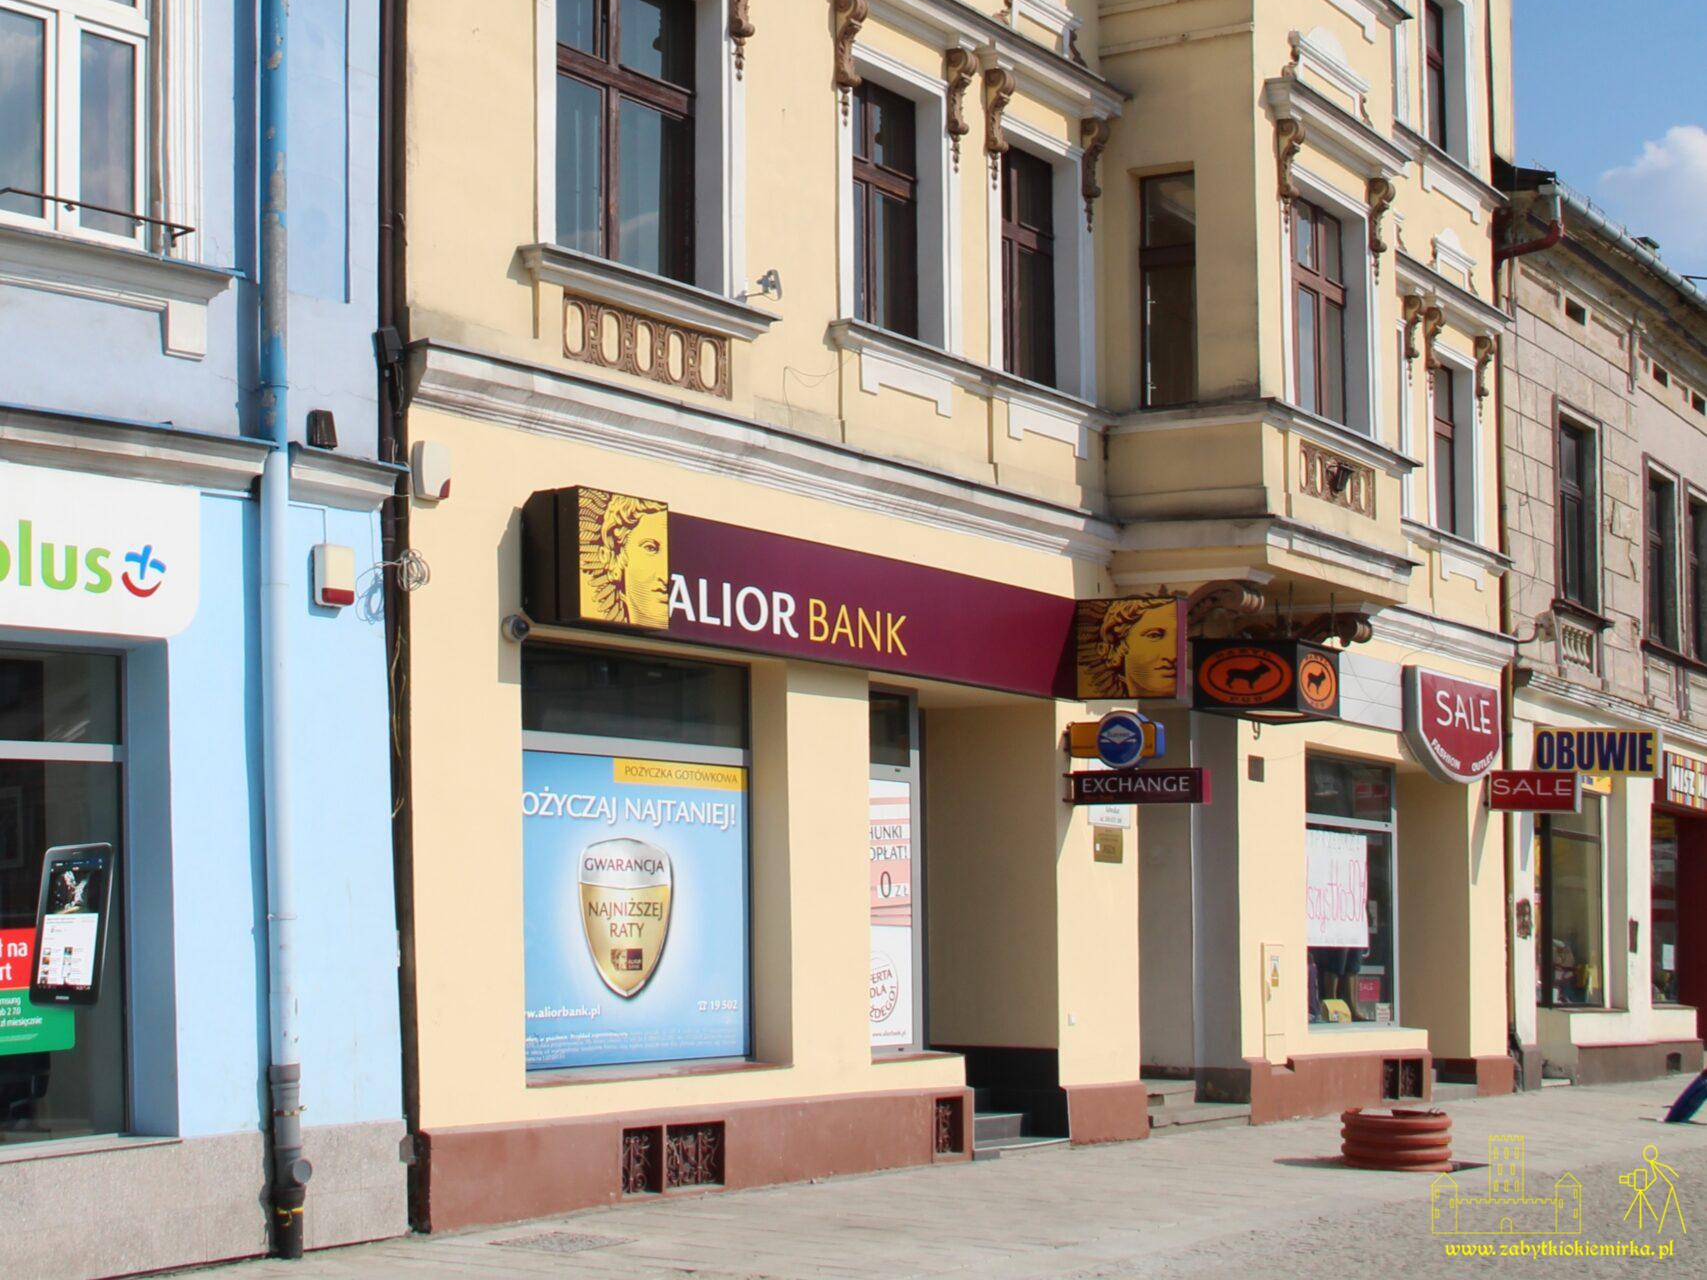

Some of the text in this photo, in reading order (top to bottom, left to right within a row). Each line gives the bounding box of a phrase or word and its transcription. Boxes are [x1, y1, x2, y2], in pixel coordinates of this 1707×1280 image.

[668, 573, 908, 656] ALIOR BANK
[1435, 689, 1492, 735] SALE
[1431, 737, 1495, 772] FASHION OUTLET
[1536, 730, 1653, 771] OBUWIE
[624, 764, 738, 783] POŻYCZKA GOTÓWKOWA
[1082, 776, 1190, 793] EXCHANGE
[1492, 778, 1573, 796] SALE
[624, 797, 736, 831] NAJTANIEJ!
[584, 857, 665, 875] GWARANCJA
[880, 870, 892, 898] 0
[588, 897, 663, 920] NAJNIŻSZEJ
[609, 922, 645, 938] RATY
[7, 940, 28, 958] na
[869, 984, 887, 998] DLA
[524, 1004, 601, 1020] w.aliorbank.pl
